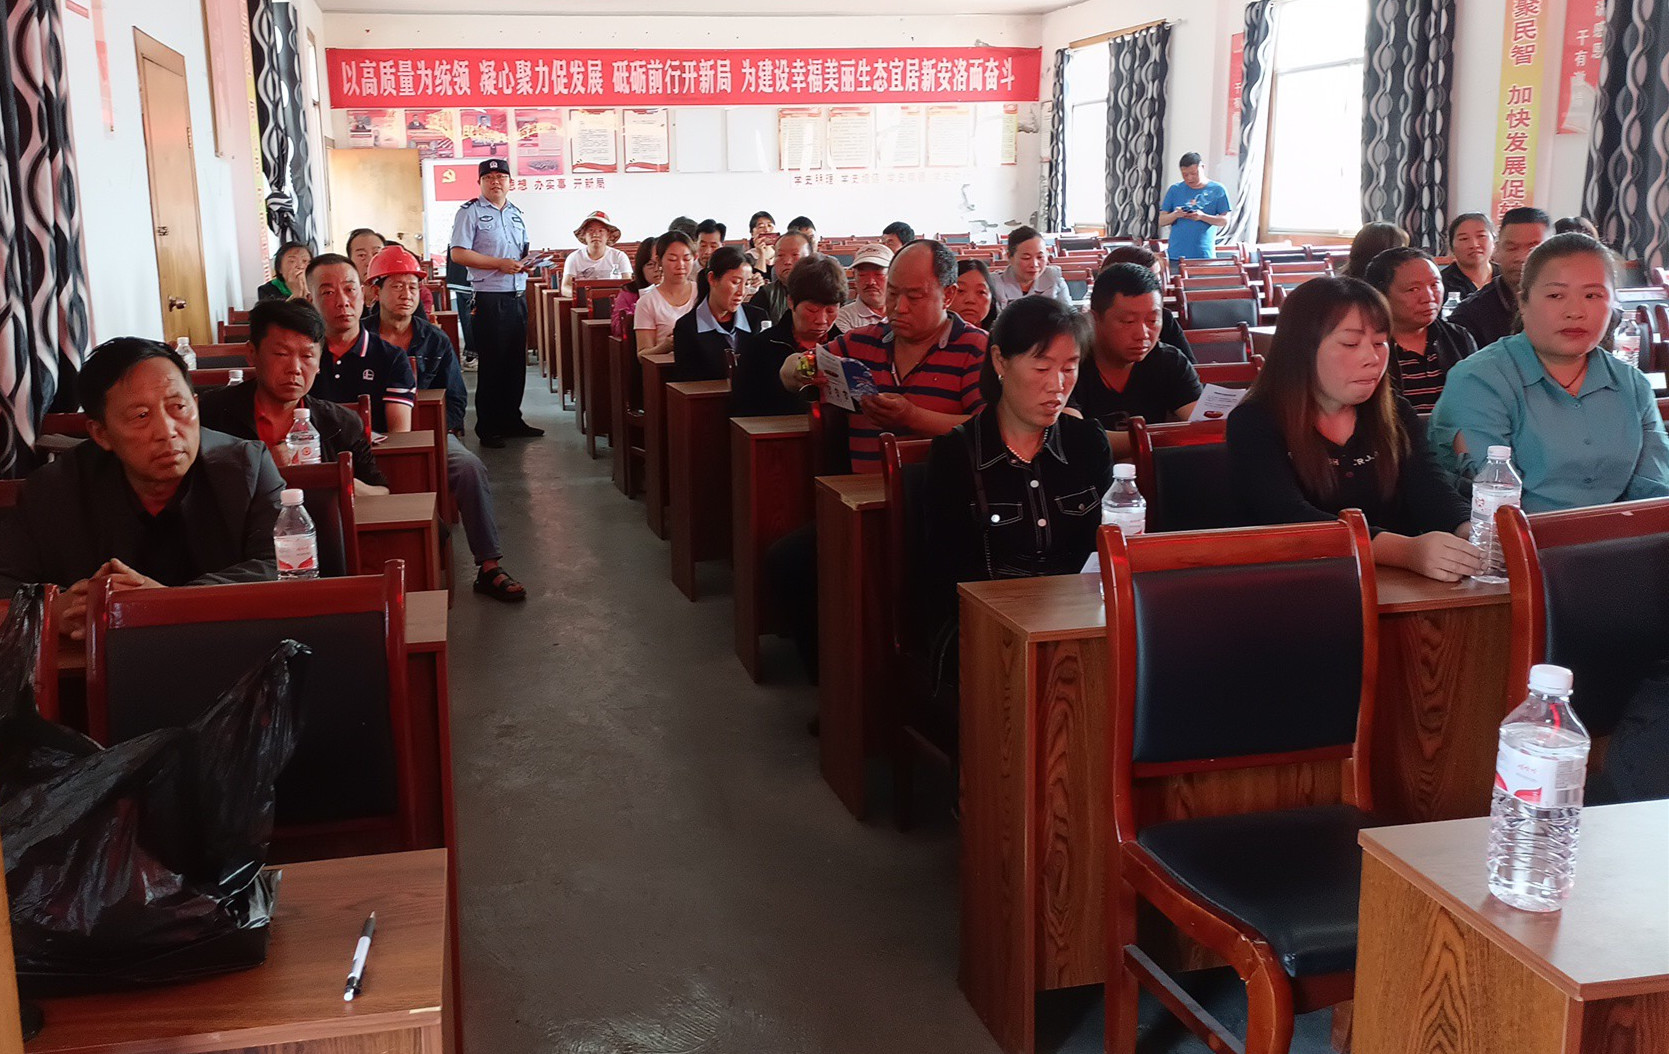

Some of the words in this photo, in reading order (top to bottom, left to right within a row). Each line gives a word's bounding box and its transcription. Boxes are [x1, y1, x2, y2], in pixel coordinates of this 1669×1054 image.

[341, 59, 471, 97] 以高质量为统领
[479, 58, 604, 96] 凝心聚力促发展
[612, 58, 732, 95] 砥砺前行开新局
[741, 56, 1016, 94] 为建设幸福美丽生态宜居新安洛而奋斗
